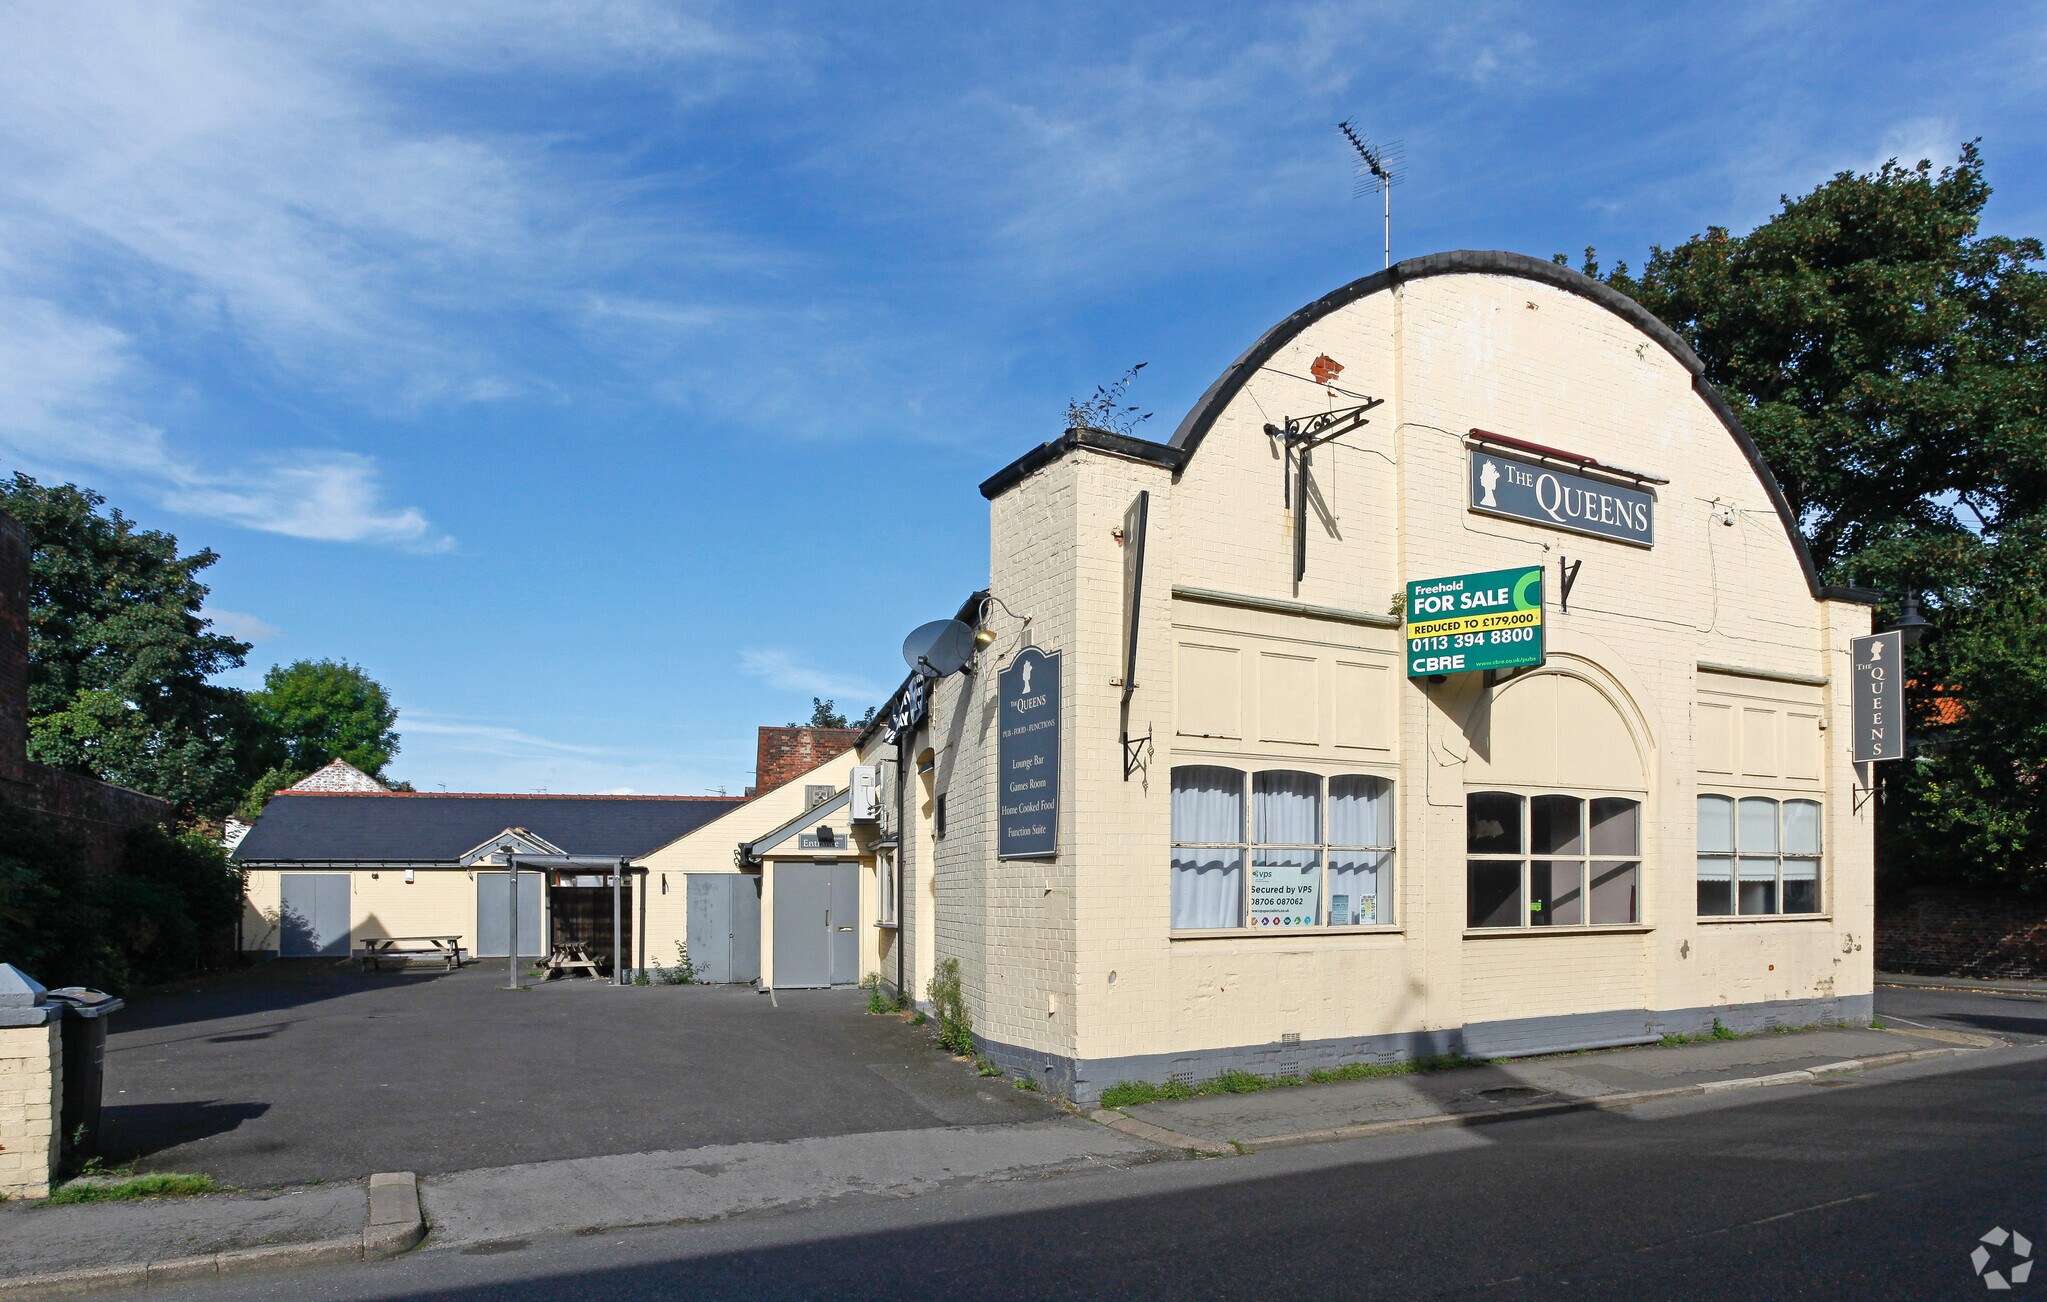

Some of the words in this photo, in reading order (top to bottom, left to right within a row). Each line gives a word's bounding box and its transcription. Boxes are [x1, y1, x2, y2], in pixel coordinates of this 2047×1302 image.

[1504, 464, 1534, 488] THE
[1535, 473, 1648, 532] QUEENS
[1415, 580, 1464, 596] Freehold
[1414, 595, 1454, 614] FOR
[1460, 588, 1509, 609] SALE
[1414, 621, 1461, 634] REDUCED
[1464, 619, 1478, 629] TO
[1482, 614, 1534, 626] £179,000
[1412, 635, 1448, 652] 0113
[1454, 632, 1484, 648] 394
[1491, 627, 1534, 644] 8800
[1412, 654, 1465, 672] CBRE
[1476, 656, 1536, 667] www.cbre.co.uk/pubs
[1856, 663, 1872, 671] THE
[1017, 694, 1047, 714] QUEENS
[1871, 667, 1885, 756] QUEENS
[1003, 729, 1011, 738] PUB
[1014, 726, 1026, 735] FOOD
[1029, 719, 1055, 731] FUNCTIONS
[1012, 759, 1032, 770] Lounge
[1034, 755, 1044, 765] Bar
[1010, 782, 1028, 792] Games
[1029, 779, 1046, 789] Room
[1002, 805, 1018, 815] Home
[1019, 801, 1039, 813] Cooked
[1041, 799, 1054, 810] Food
[1008, 826, 1030, 837] Function
[1032, 825, 1046, 834] Suite
[1286, 886, 1295, 894] by
